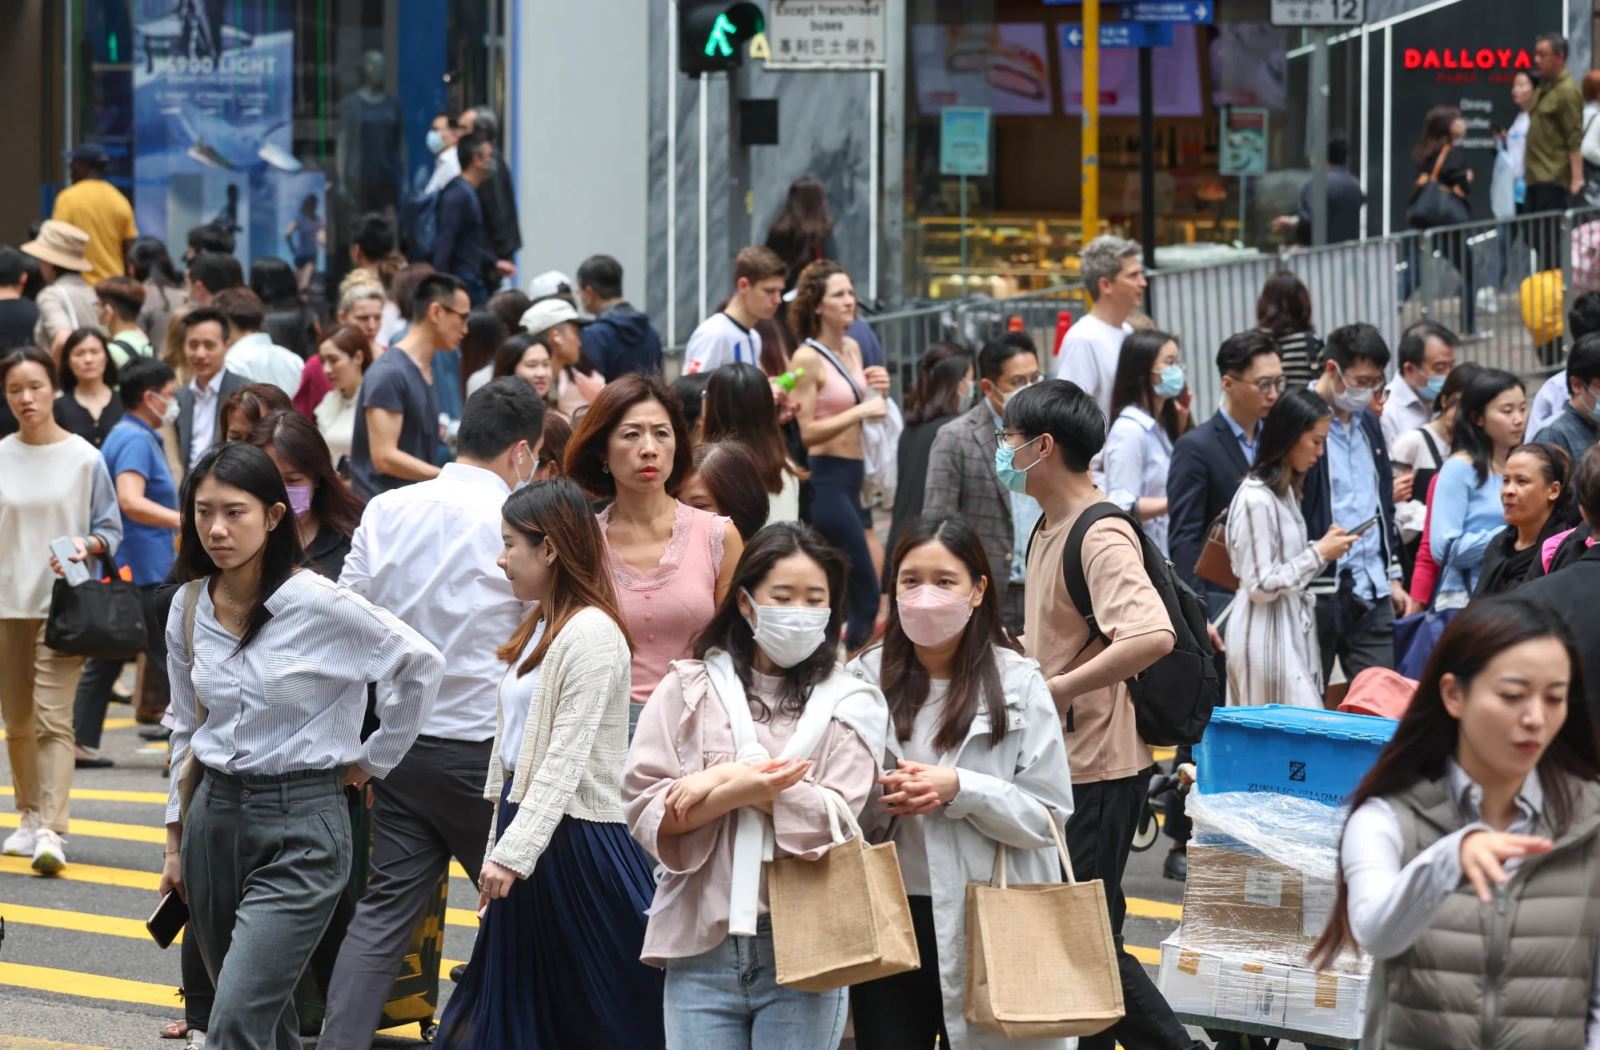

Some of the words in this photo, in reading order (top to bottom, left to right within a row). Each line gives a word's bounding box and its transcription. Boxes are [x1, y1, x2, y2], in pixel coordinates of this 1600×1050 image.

[775, 4, 815, 18] Except
[818, 3, 880, 17] franchised
[1332, 0, 1357, 20] 12
[810, 20, 843, 32] buses
[219, 55, 276, 75] LIGHT
[1403, 48, 1533, 69] DALLOYA
